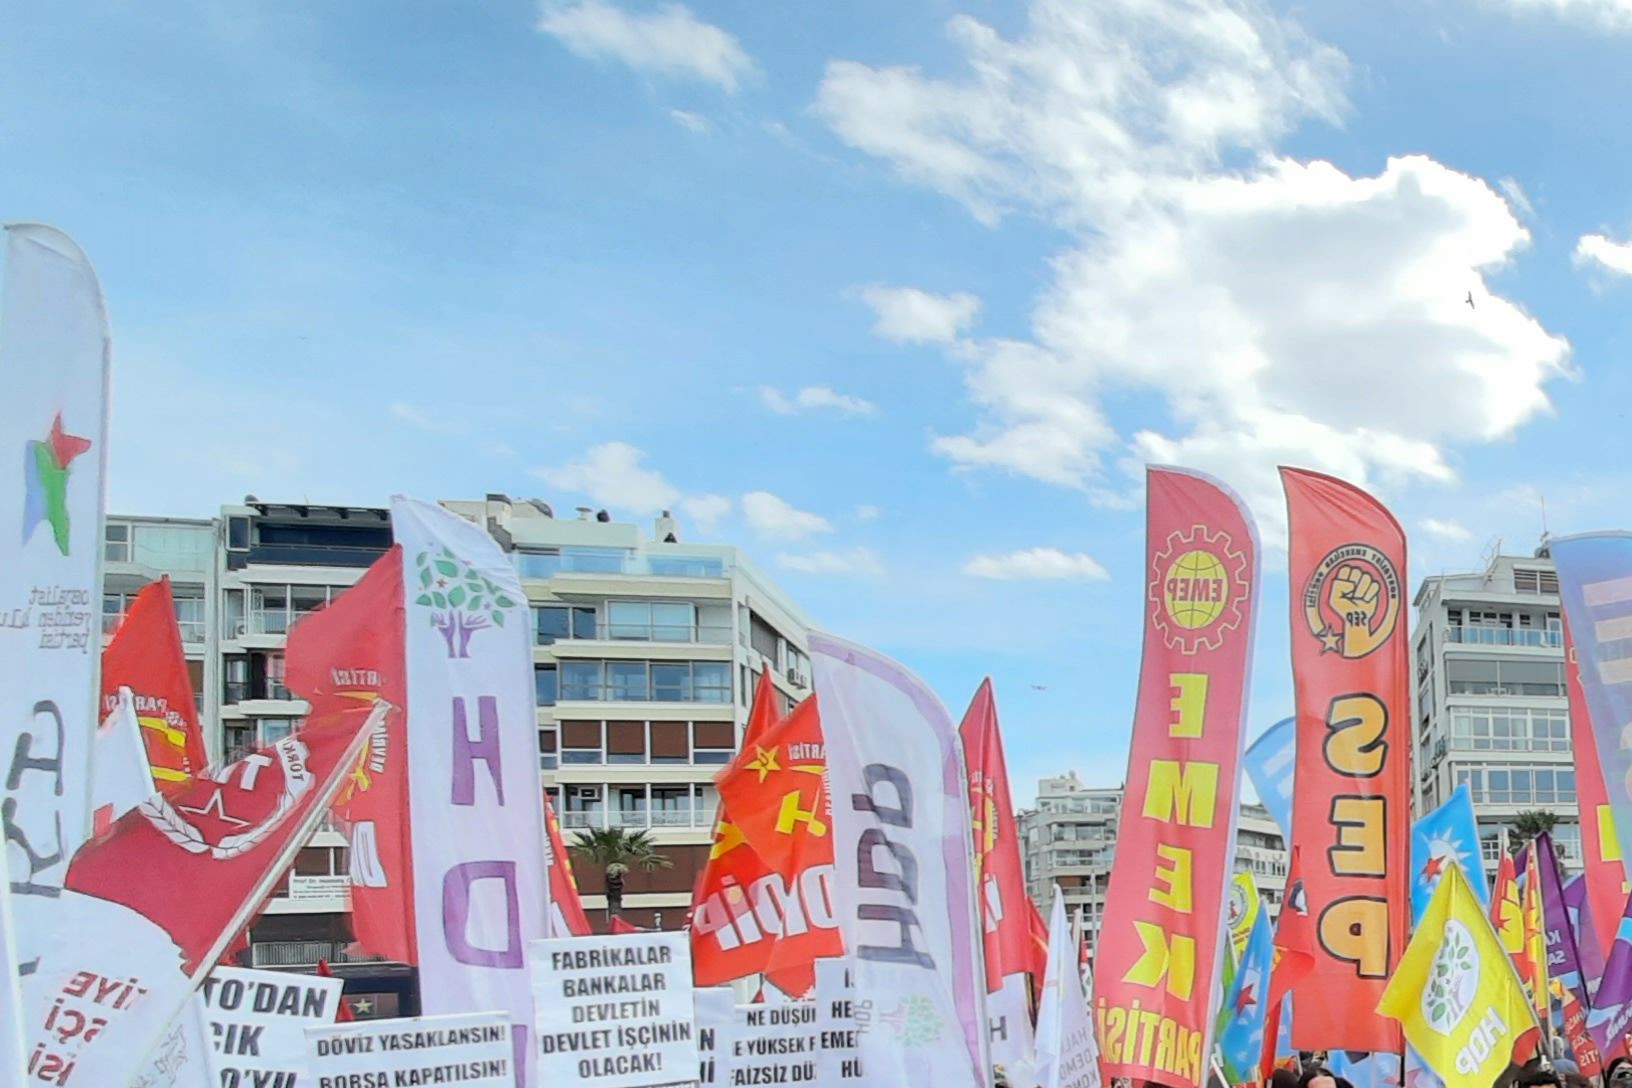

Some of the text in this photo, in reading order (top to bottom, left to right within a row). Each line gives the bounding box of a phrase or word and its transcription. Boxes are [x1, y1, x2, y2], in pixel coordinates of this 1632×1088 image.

[552, 946, 672, 971] FABRİKALAR
[563, 973, 667, 998] BANKALAR
[571, 998, 661, 1024] DEVLETİN
[317, 1024, 506, 1057] DÖVİZ YASAKLANSIN!
[542, 1022, 692, 1055] DEVLET İŞÇİNİN
[747, 1038, 809, 1056] YÜKSEK
[394, 1059, 508, 1088] KAPATILSIN!
[578, 1052, 663, 1079] OLACAK!
